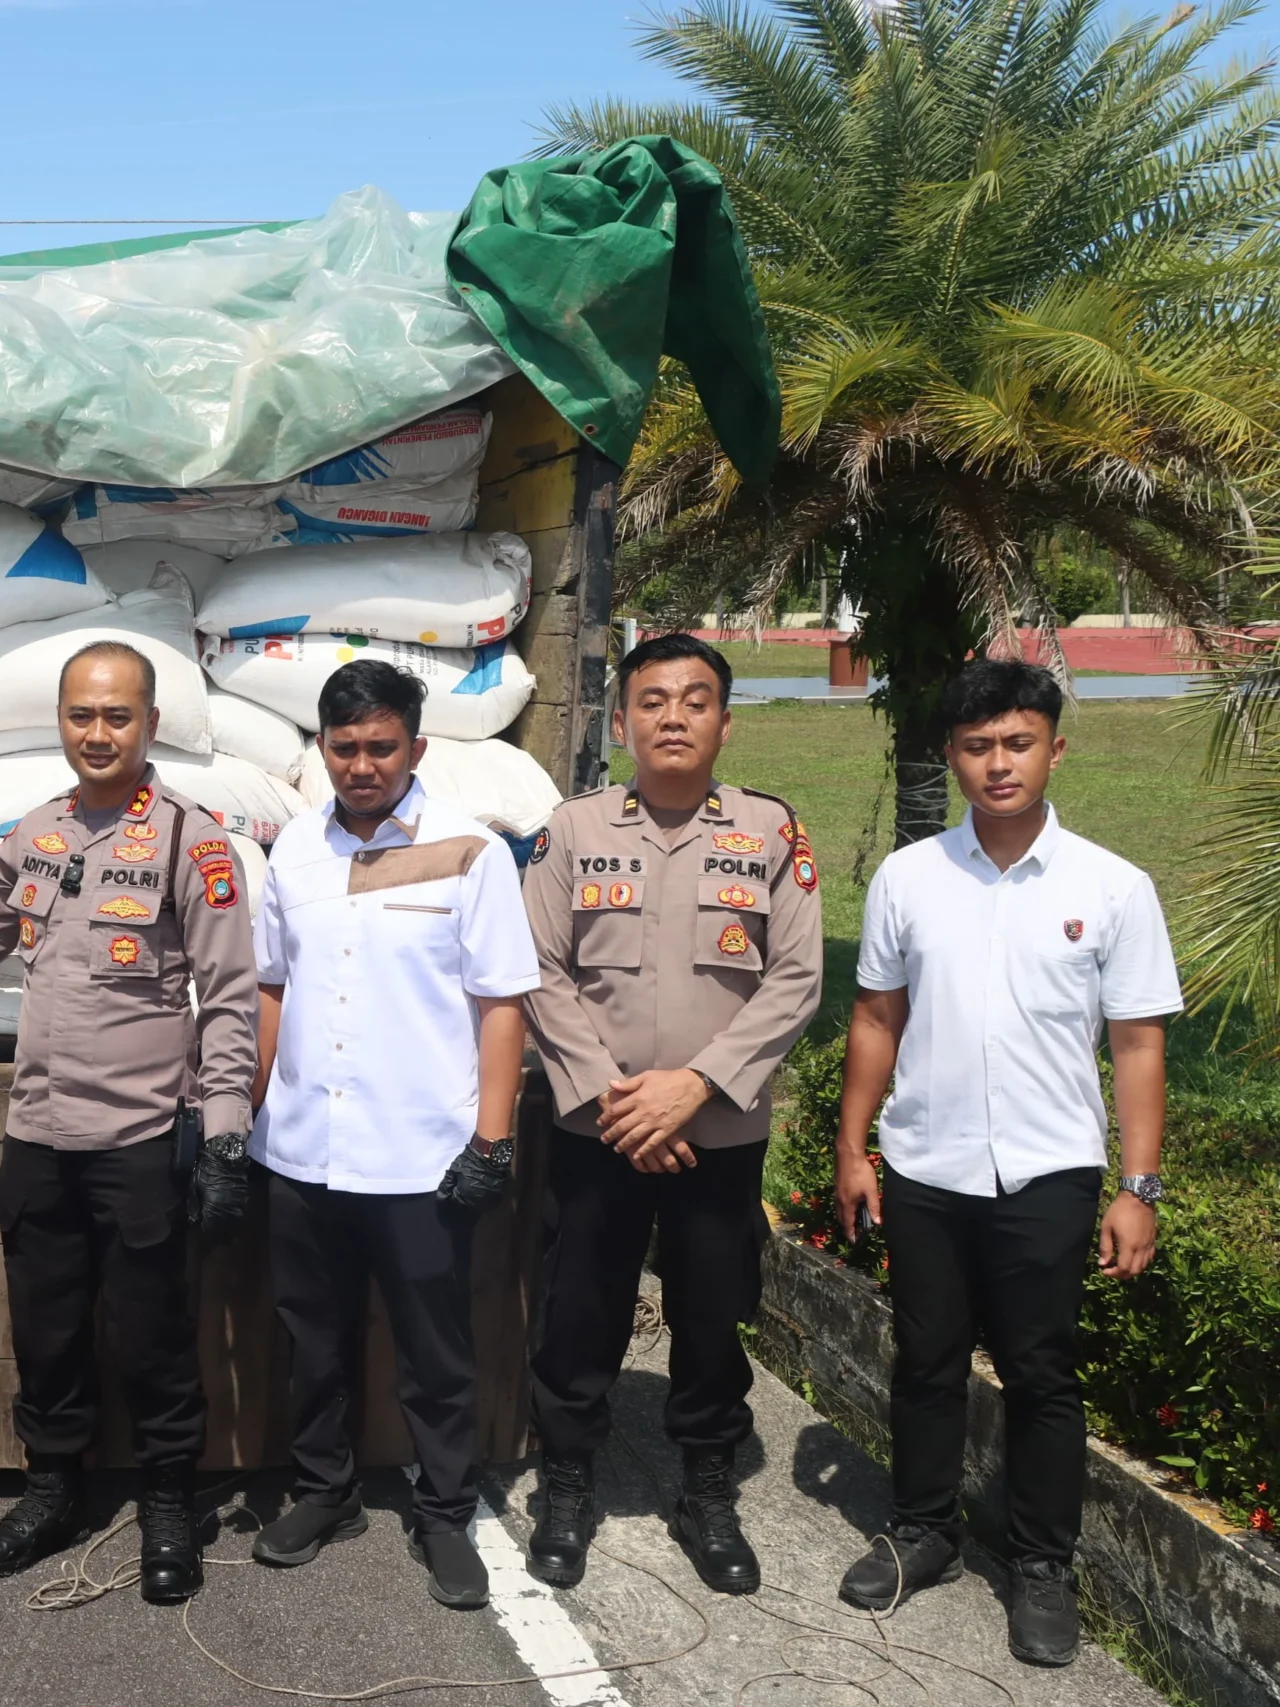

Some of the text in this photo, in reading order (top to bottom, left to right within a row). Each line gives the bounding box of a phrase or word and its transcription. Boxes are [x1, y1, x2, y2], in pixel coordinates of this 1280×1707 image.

[337, 507, 431, 527] JANGAN DIGANCU
[193, 841, 225, 858] POLDA
[22, 854, 61, 880] ADITYA
[579, 857, 642, 875] YOS S
[704, 857, 767, 880] POLRI
[101, 868, 160, 888] POLRI
